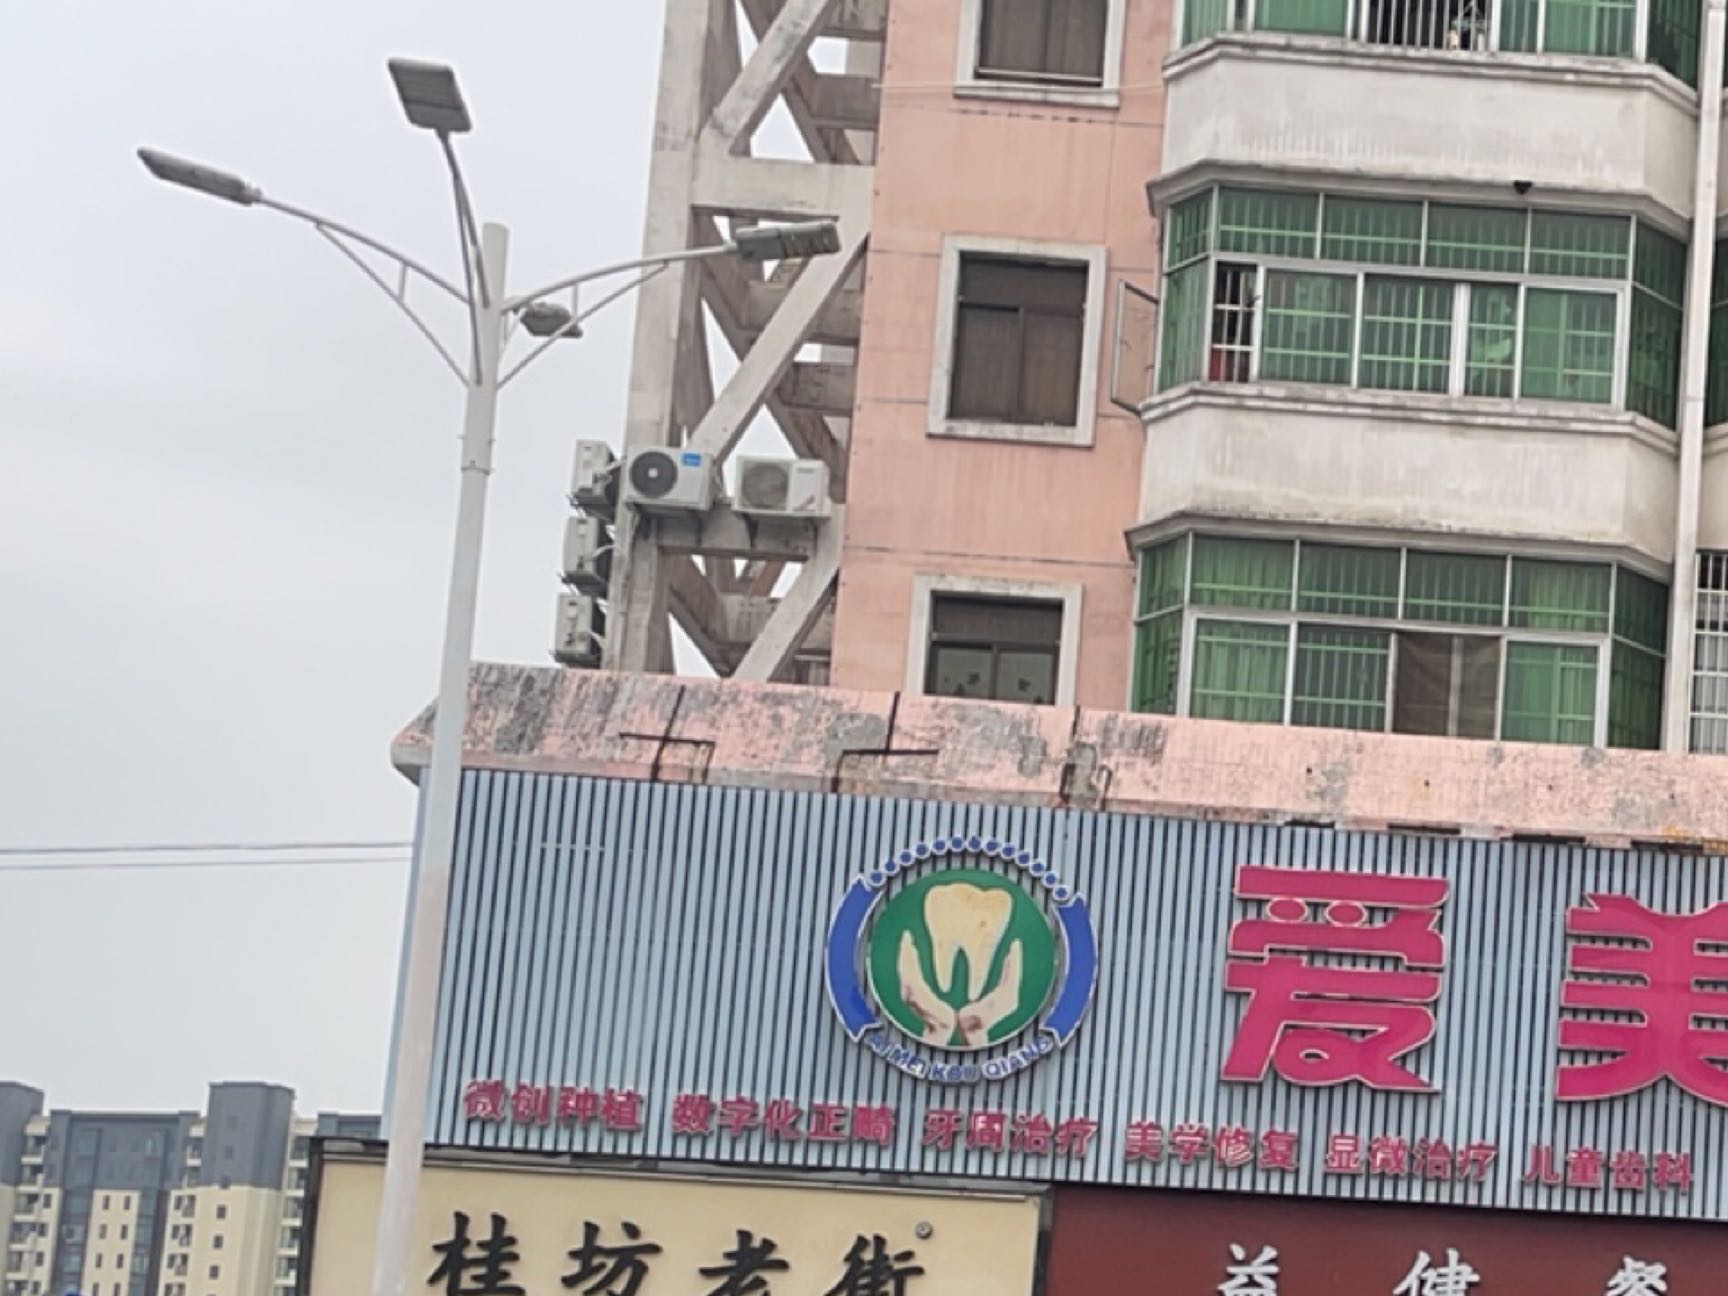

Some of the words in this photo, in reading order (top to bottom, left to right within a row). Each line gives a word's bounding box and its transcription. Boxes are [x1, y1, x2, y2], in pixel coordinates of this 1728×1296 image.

[463, 1079, 643, 1131] 微创种植
[672, 1093, 897, 1146] 数字化正畸
[922, 1110, 1099, 1160] 牙周治疗
[1124, 1120, 1300, 1173] 美学修复
[1324, 1135, 1499, 1184] 显微治疗
[1523, 1147, 1695, 1196] 儿童齿科
